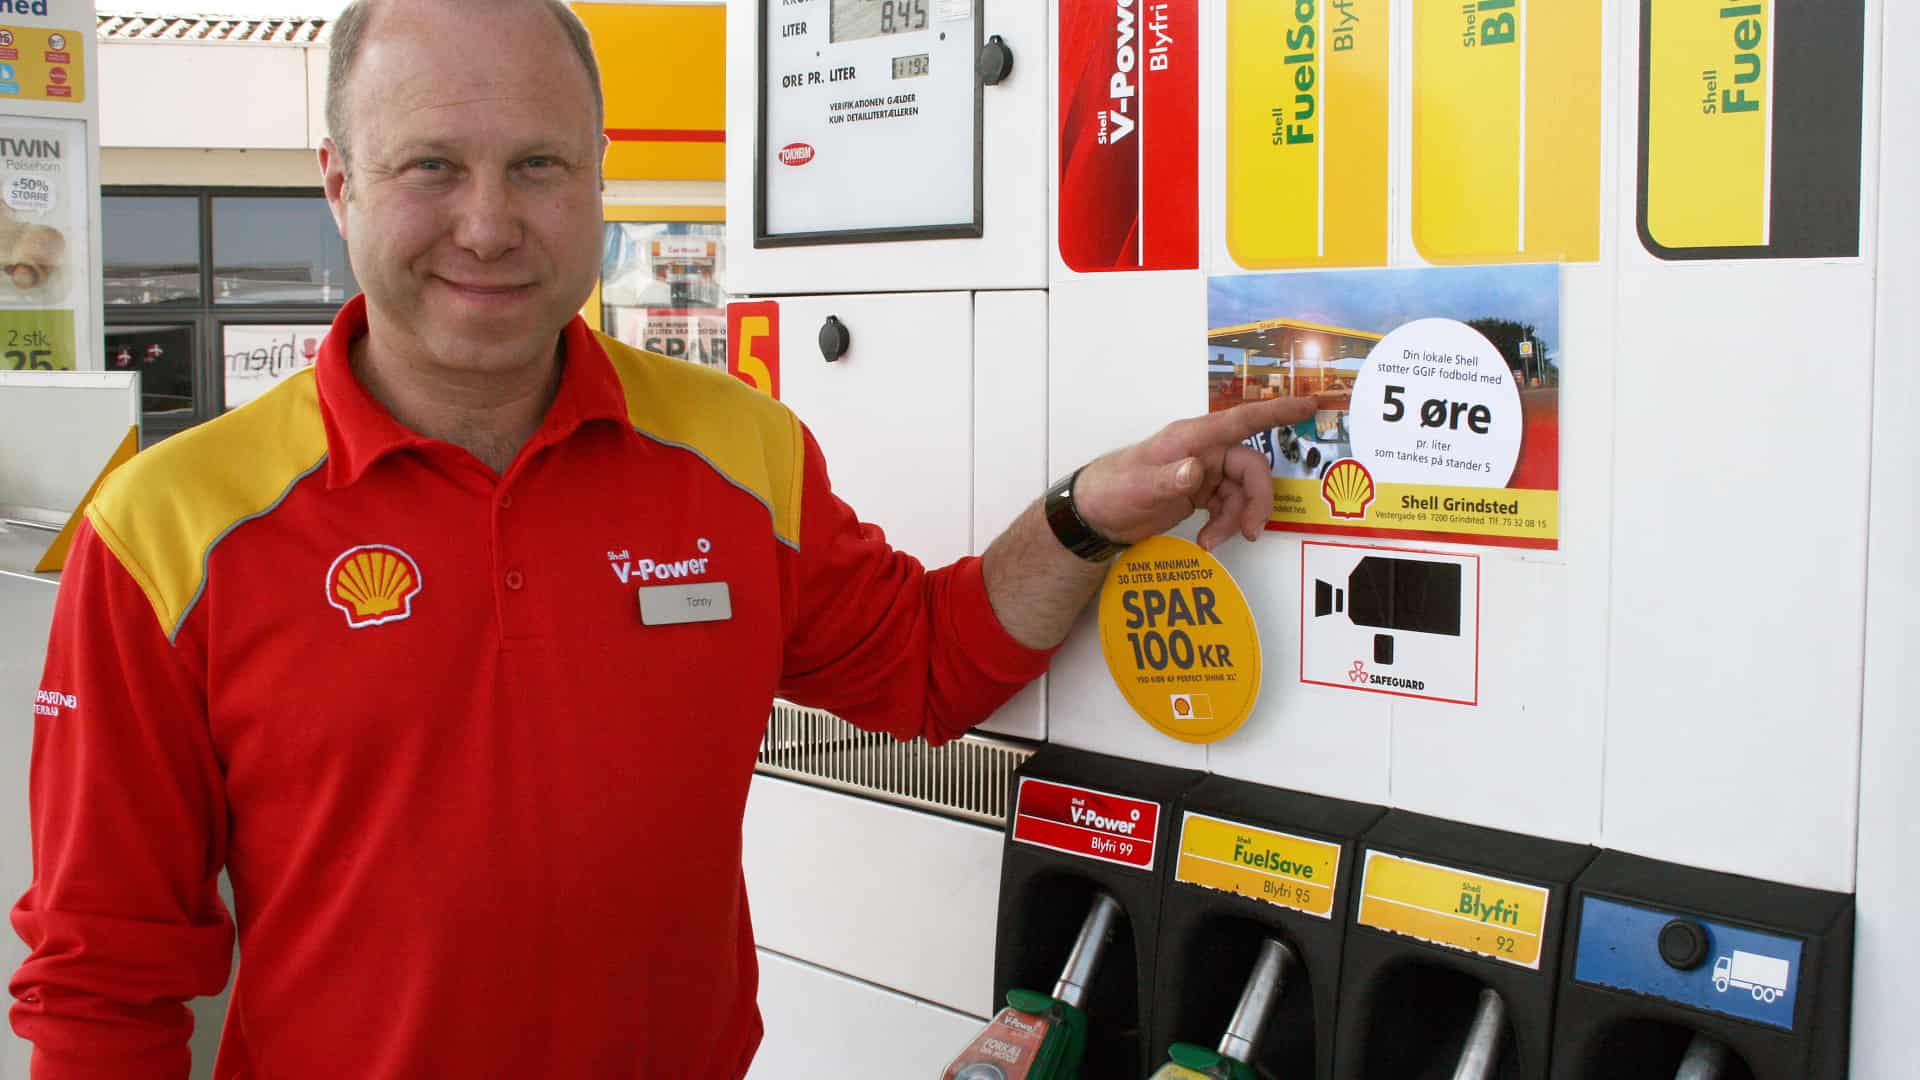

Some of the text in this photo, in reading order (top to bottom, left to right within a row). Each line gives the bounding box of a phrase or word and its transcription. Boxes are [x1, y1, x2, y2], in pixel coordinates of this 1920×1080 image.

[782, 22, 807, 38] LITER
[1463, 4, 1476, 47] Shell
[1148, 4, 1174, 71] Blyfri
[1720, 0, 1762, 113] Fuel
[782, 66, 856, 88] ØRE PR. LITER
[1110, 0, 1135, 145] V-Pow
[1284, 0, 1315, 145] FuelSa
[830, 94, 916, 111] VERIFIKATIONEN GÆLDER
[1702, 70, 1717, 114] Shell
[829, 115, 844, 124] KUN
[1098, 111, 1107, 145] Shell
[1272, 107, 1283, 146] Shell
[0, 137, 60, 158] TWIN
[12, 178, 49, 192] +50%
[7, 330, 18, 347] 2
[4, 350, 69, 371] 25
[737, 316, 772, 400] 5
[1403, 350, 1479, 367] Din lokale Shell
[1377, 363, 1502, 385] støtter GGIF fodbold med
[1382, 384, 1492, 434] 5 øre
[1416, 439, 1451, 451] pr. liter
[1374, 449, 1491, 473] som tankes på stander 5
[1401, 495, 1519, 515] Shell Grindsted
[1375, 511, 1416, 523] Vestergade
[1431, 513, 1448, 522] 7200
[1514, 518, 1523, 527] 32
[607, 550, 630, 560] Shell
[1127, 558, 1200, 572] TANK MINIMUM
[611, 558, 708, 584] V-Power
[1118, 569, 1214, 585] 30 LITER BRÆNDSTOF
[1123, 587, 1223, 629] SPAR
[1128, 629, 1234, 671] 100 KR
[1370, 674, 1425, 690] SAFEGUARD
[1071, 806, 1136, 835] V-Power
[1091, 836, 1133, 857] Blyfri 99
[1234, 844, 1313, 878] FuelSave
[1264, 880, 1311, 903] Blyfri 95
[1460, 892, 1519, 925] Blyfri
[1497, 936, 1514, 953] 92
